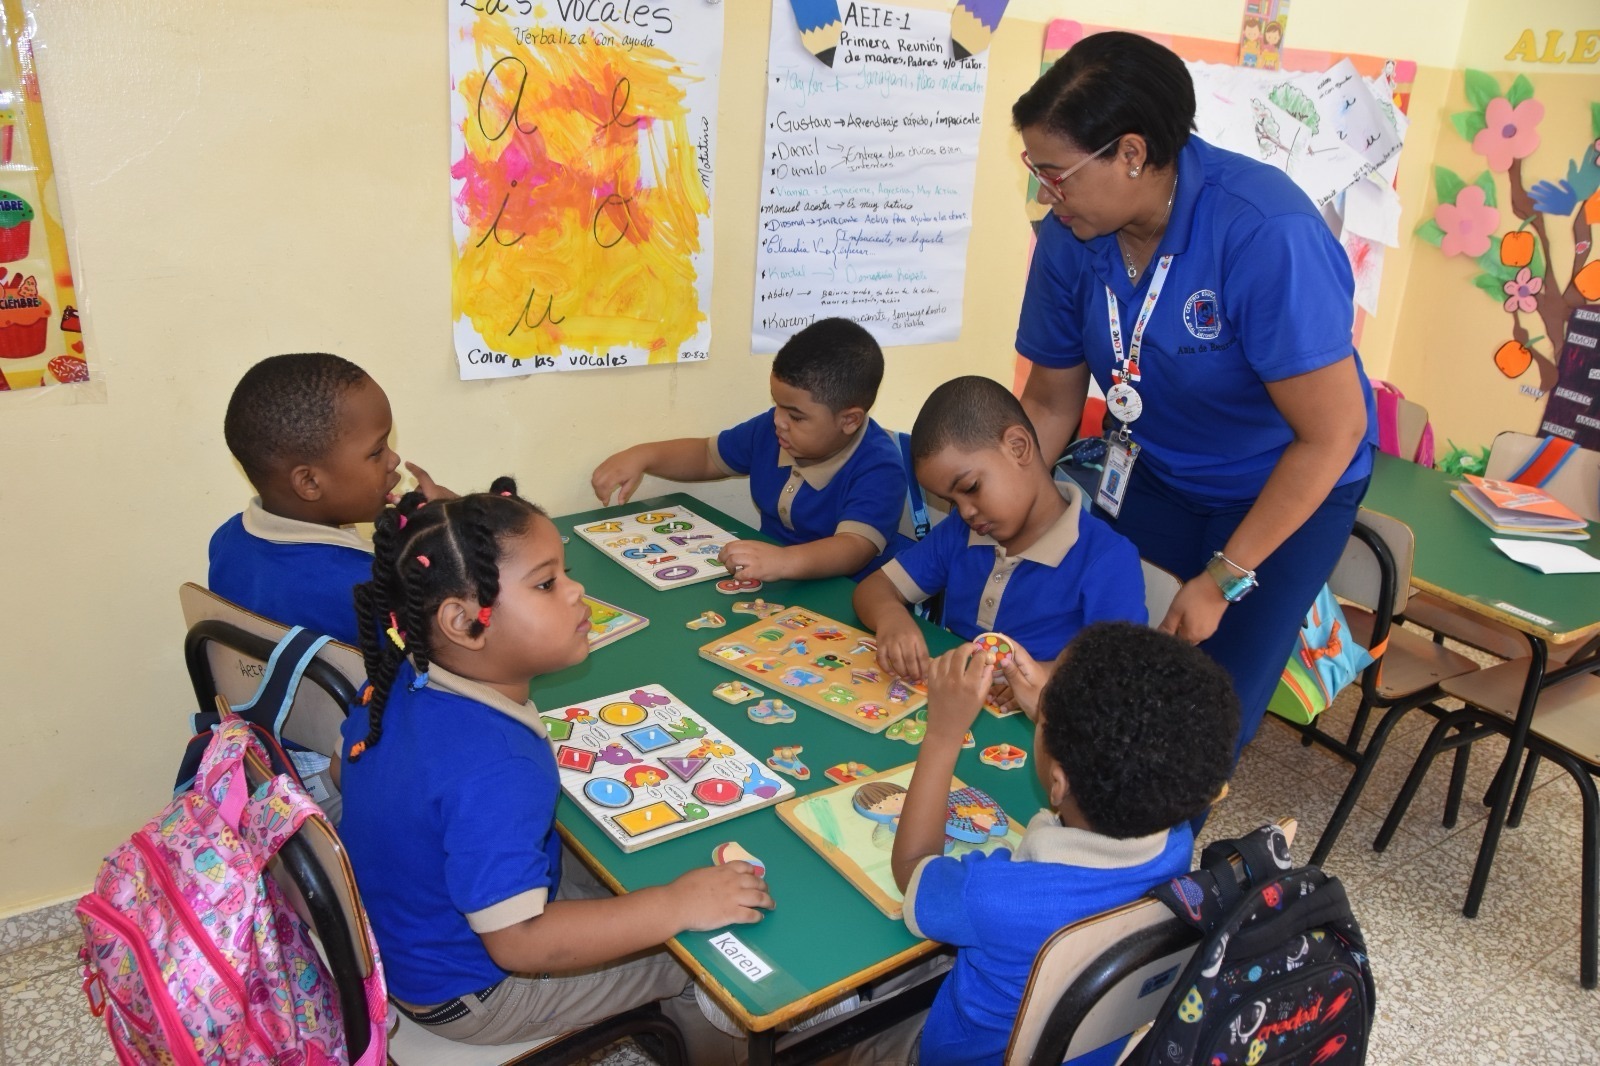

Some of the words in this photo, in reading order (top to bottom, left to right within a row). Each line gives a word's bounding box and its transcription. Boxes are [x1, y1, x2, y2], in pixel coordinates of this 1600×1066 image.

[844, 2, 912, 30] AEIE-1
[516, 28, 587, 46] Verbaliza
[621, 34, 655, 52] ayuda
[840, 31, 891, 50] Primera
[898, 37, 944, 54] Reunión
[844, 51, 862, 63] de
[907, 56, 938, 68] Padres
[943, 58, 956, 70] y/o
[777, 111, 831, 132] Gustavo
[777, 137, 819, 160] Danil
[1569, 334, 1596, 348] AMOR
[535, 355, 555, 368] las
[570, 354, 628, 367] vocales
[716, 937, 763, 978] Karen
